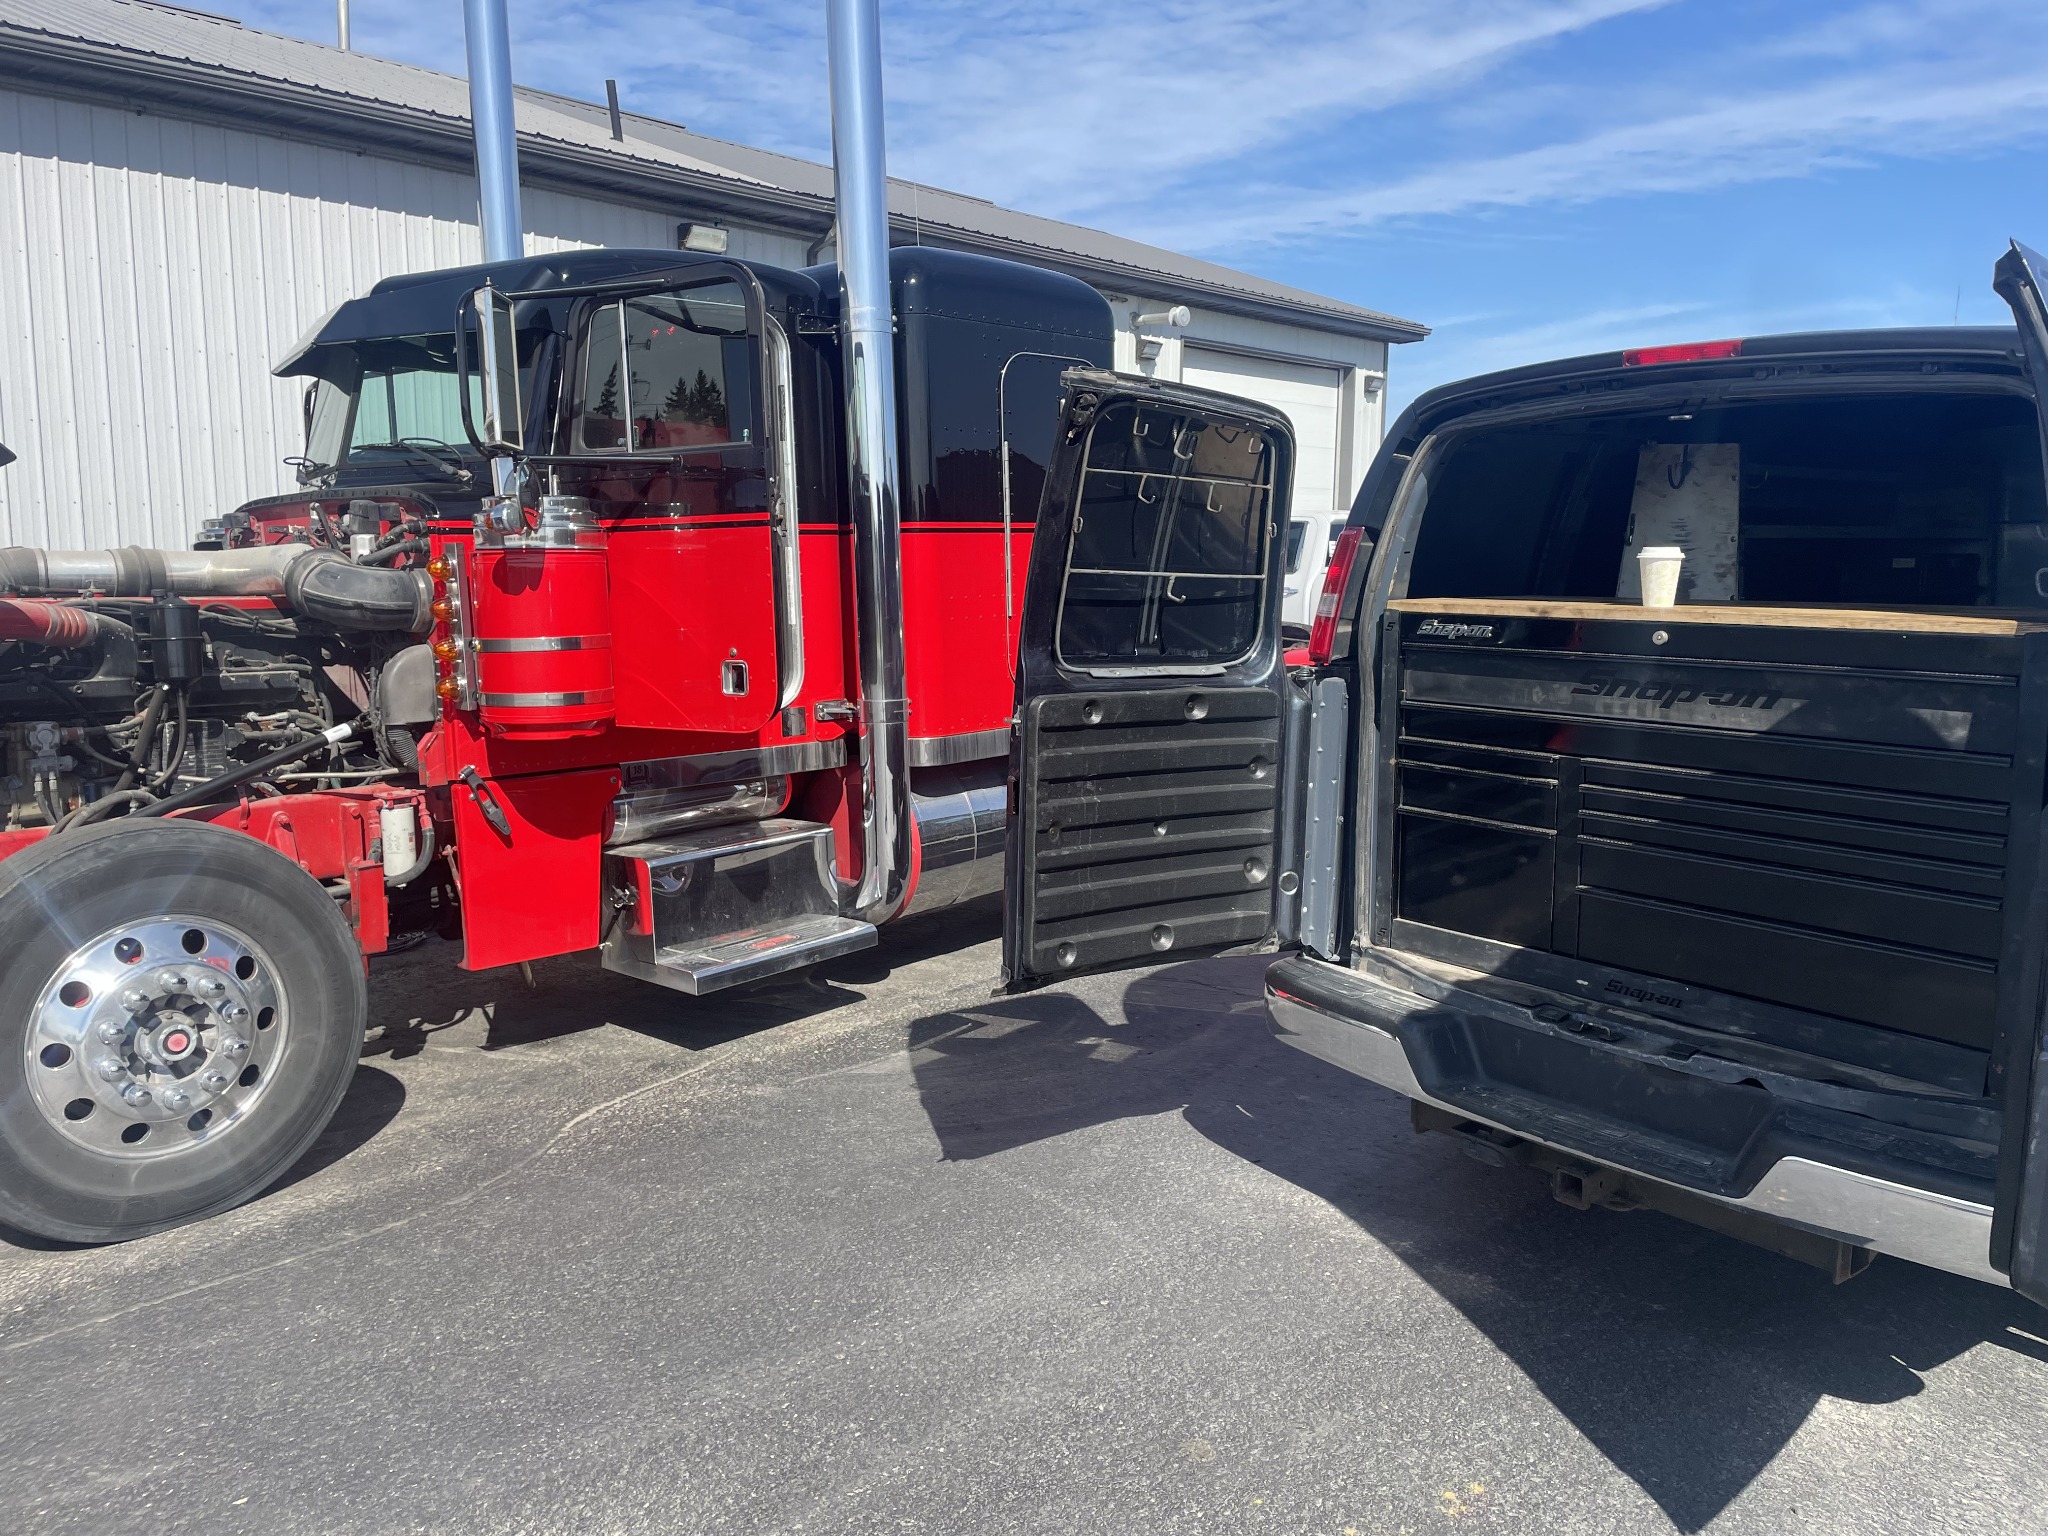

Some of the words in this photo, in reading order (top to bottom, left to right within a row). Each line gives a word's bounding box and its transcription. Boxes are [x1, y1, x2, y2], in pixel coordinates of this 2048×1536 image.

[1417, 619, 1493, 639] Snap-on
[1571, 669, 1782, 710] Snap-on
[1603, 978, 1683, 1009] Snap-on
